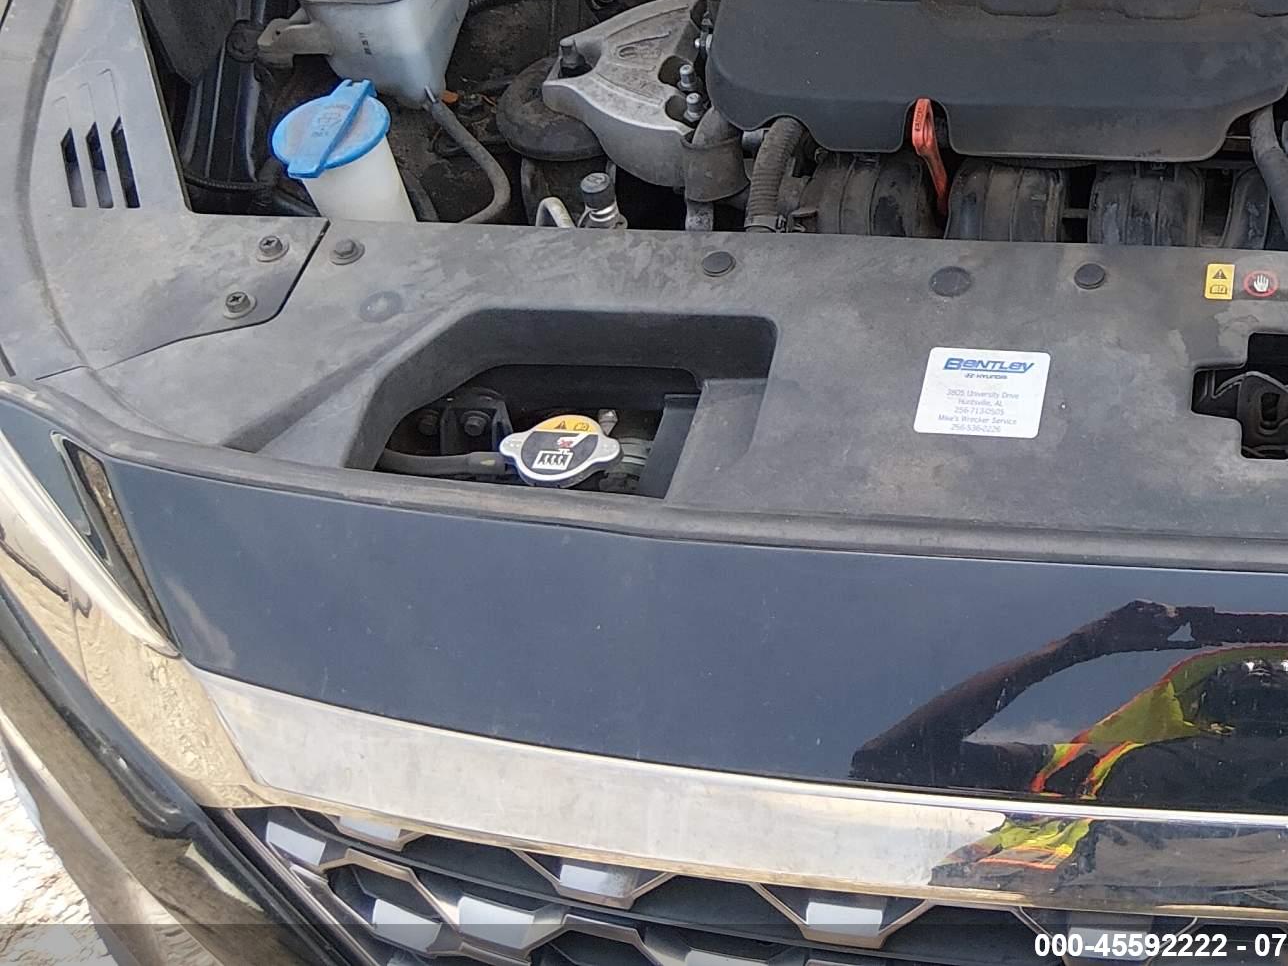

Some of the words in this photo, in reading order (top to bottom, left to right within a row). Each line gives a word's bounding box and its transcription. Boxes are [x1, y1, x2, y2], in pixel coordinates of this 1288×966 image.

[967, 389, 1000, 399] University
[1001, 391, 1020, 399] Drive
[961, 415, 990, 424] Wrecker
[991, 417, 1017, 425] Service
